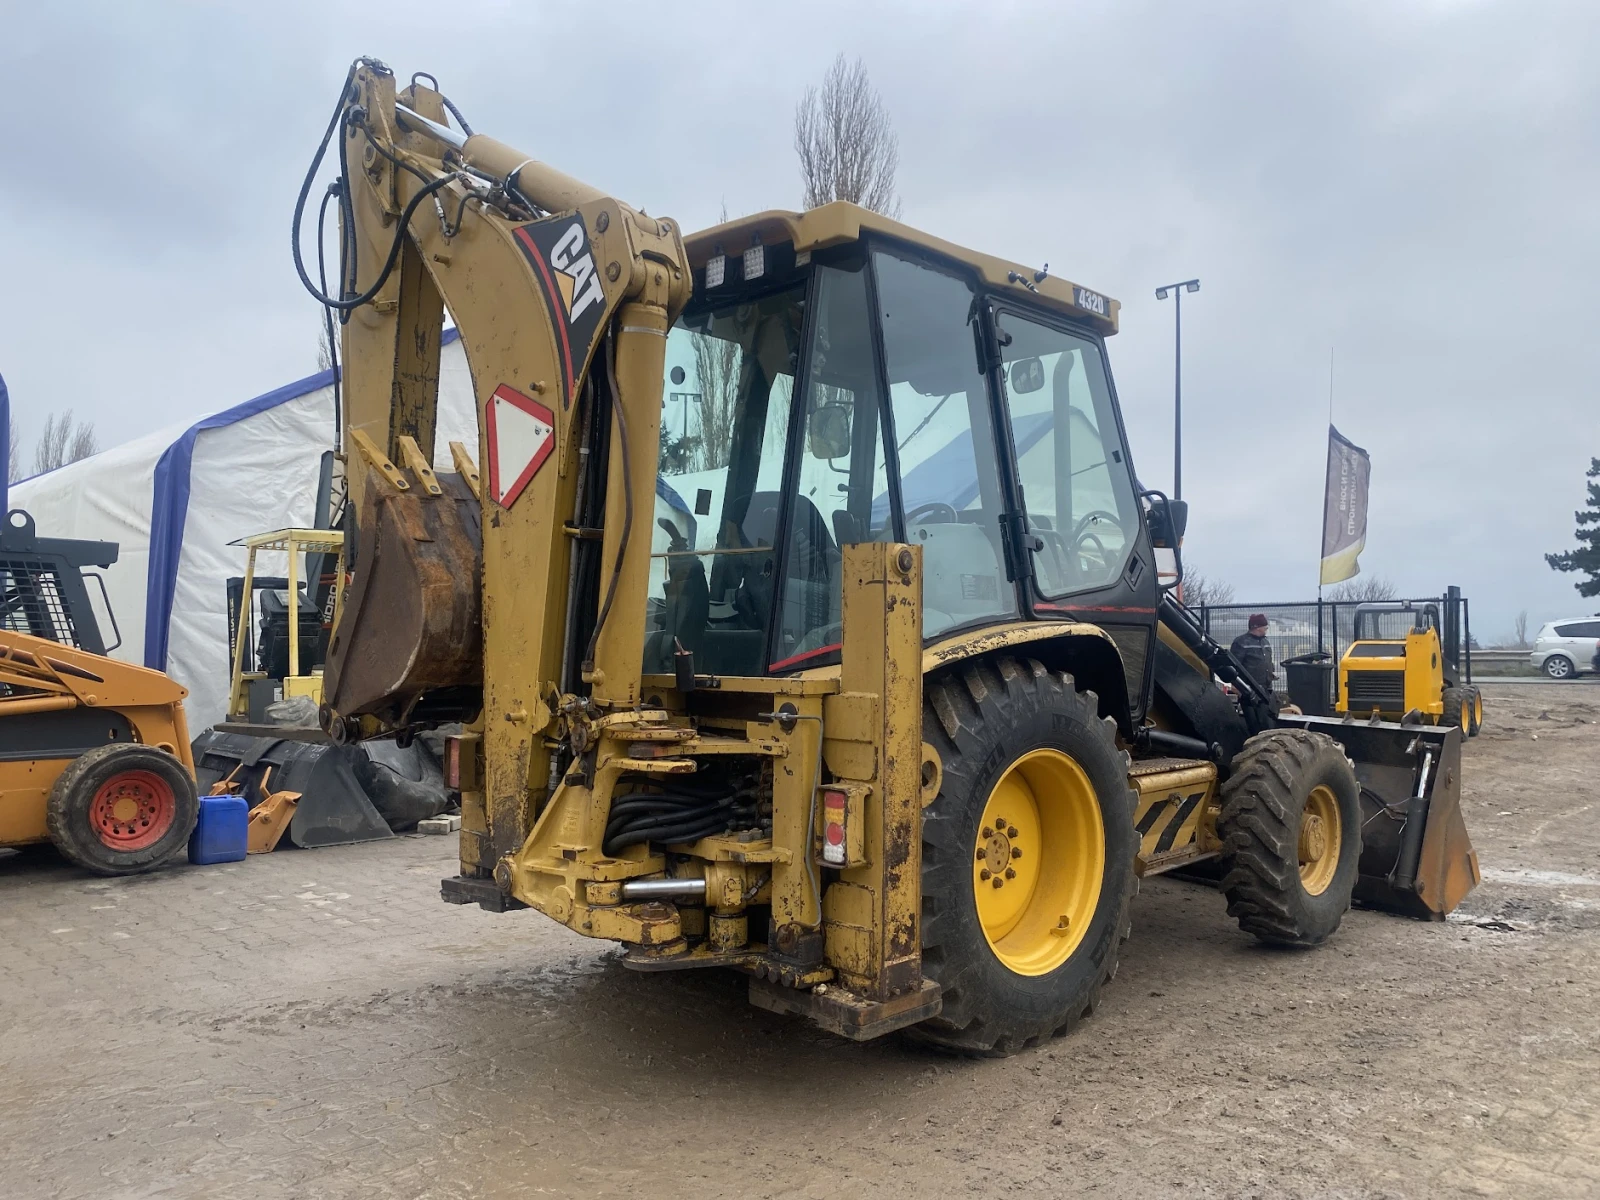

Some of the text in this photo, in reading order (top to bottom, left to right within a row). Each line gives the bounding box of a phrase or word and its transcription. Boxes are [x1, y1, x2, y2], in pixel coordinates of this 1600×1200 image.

[551, 223, 604, 324] CAT
[1079, 289, 1104, 314] 432D
[1347, 475, 1357, 536] СТРОИТЕЛНА
